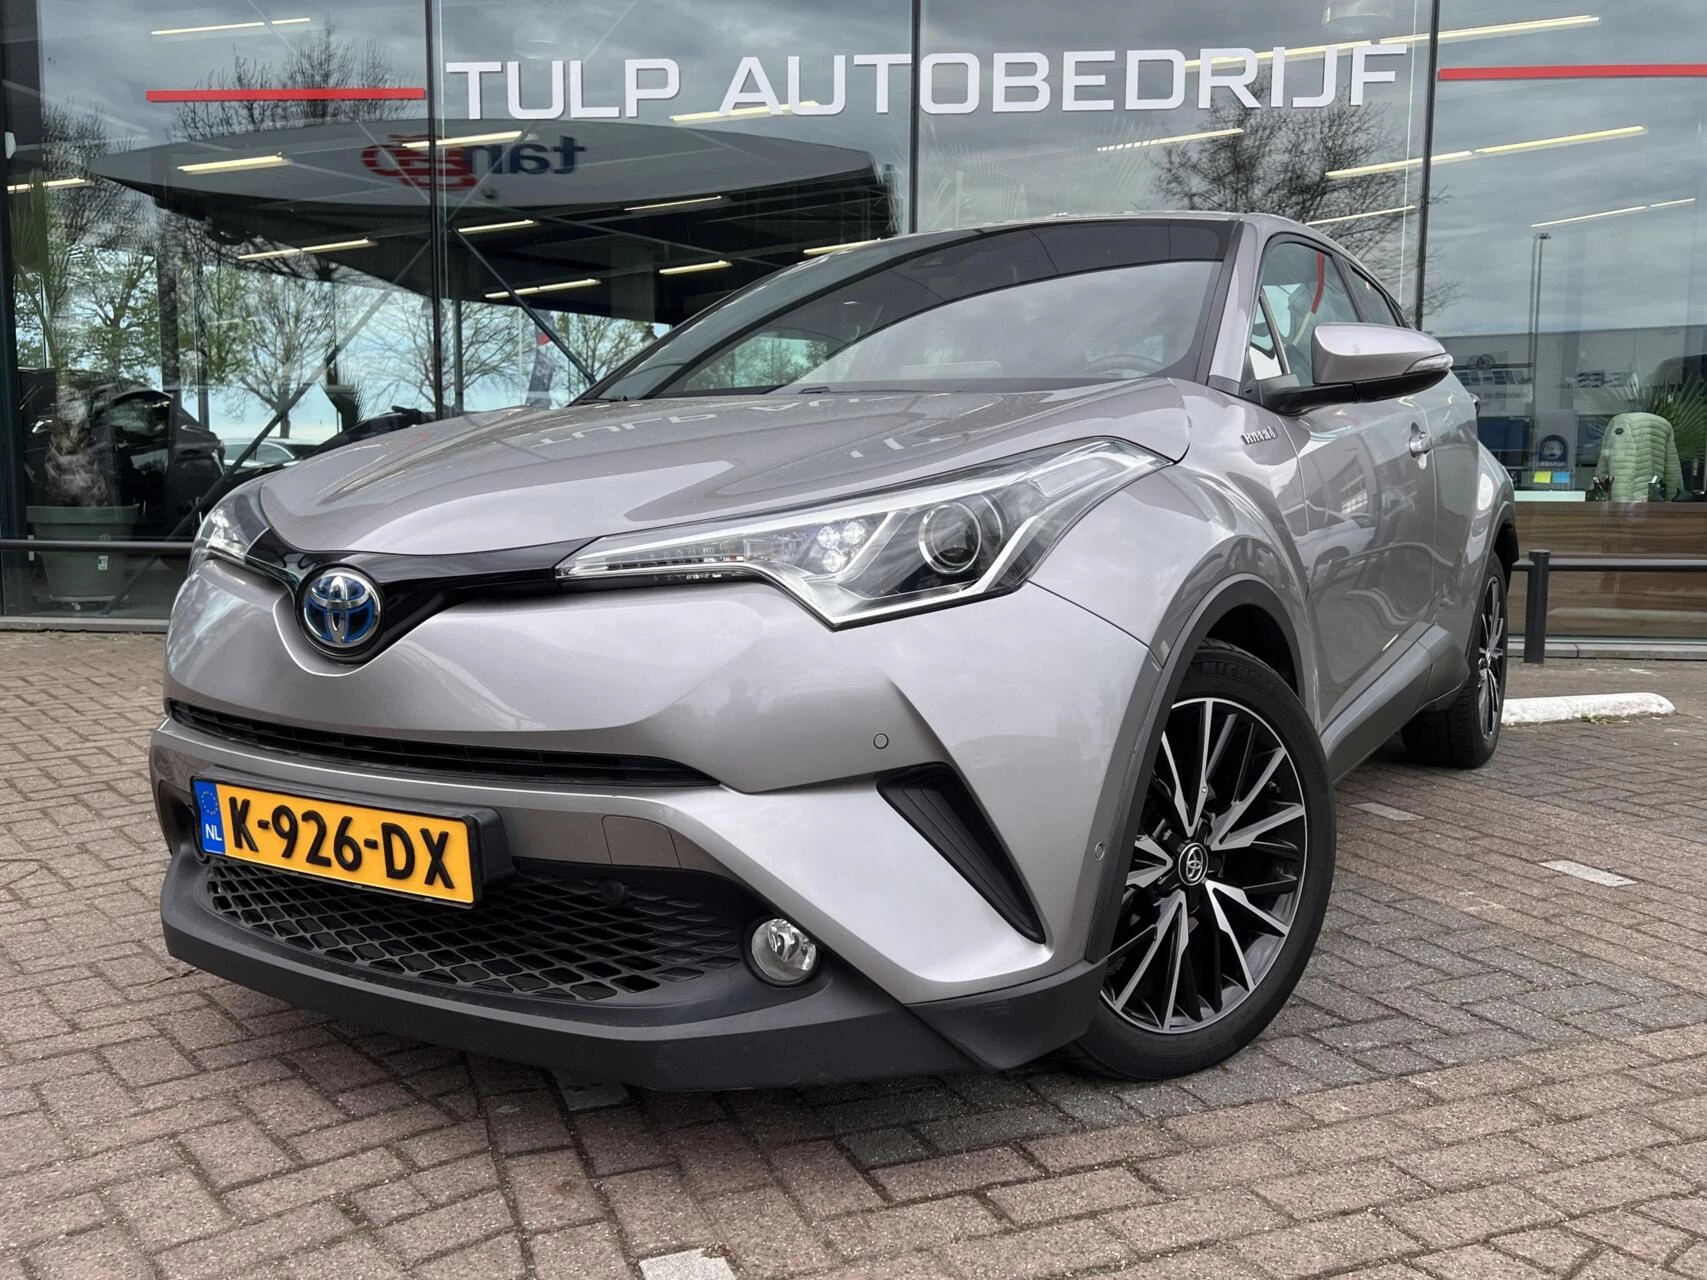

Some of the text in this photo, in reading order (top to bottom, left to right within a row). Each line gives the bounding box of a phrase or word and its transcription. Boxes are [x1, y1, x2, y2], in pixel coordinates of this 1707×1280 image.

[446, 44, 1407, 119] TULP AUTOBEDRIJF
[205, 823, 222, 841] NL
[229, 796, 455, 889] K-926-DX
